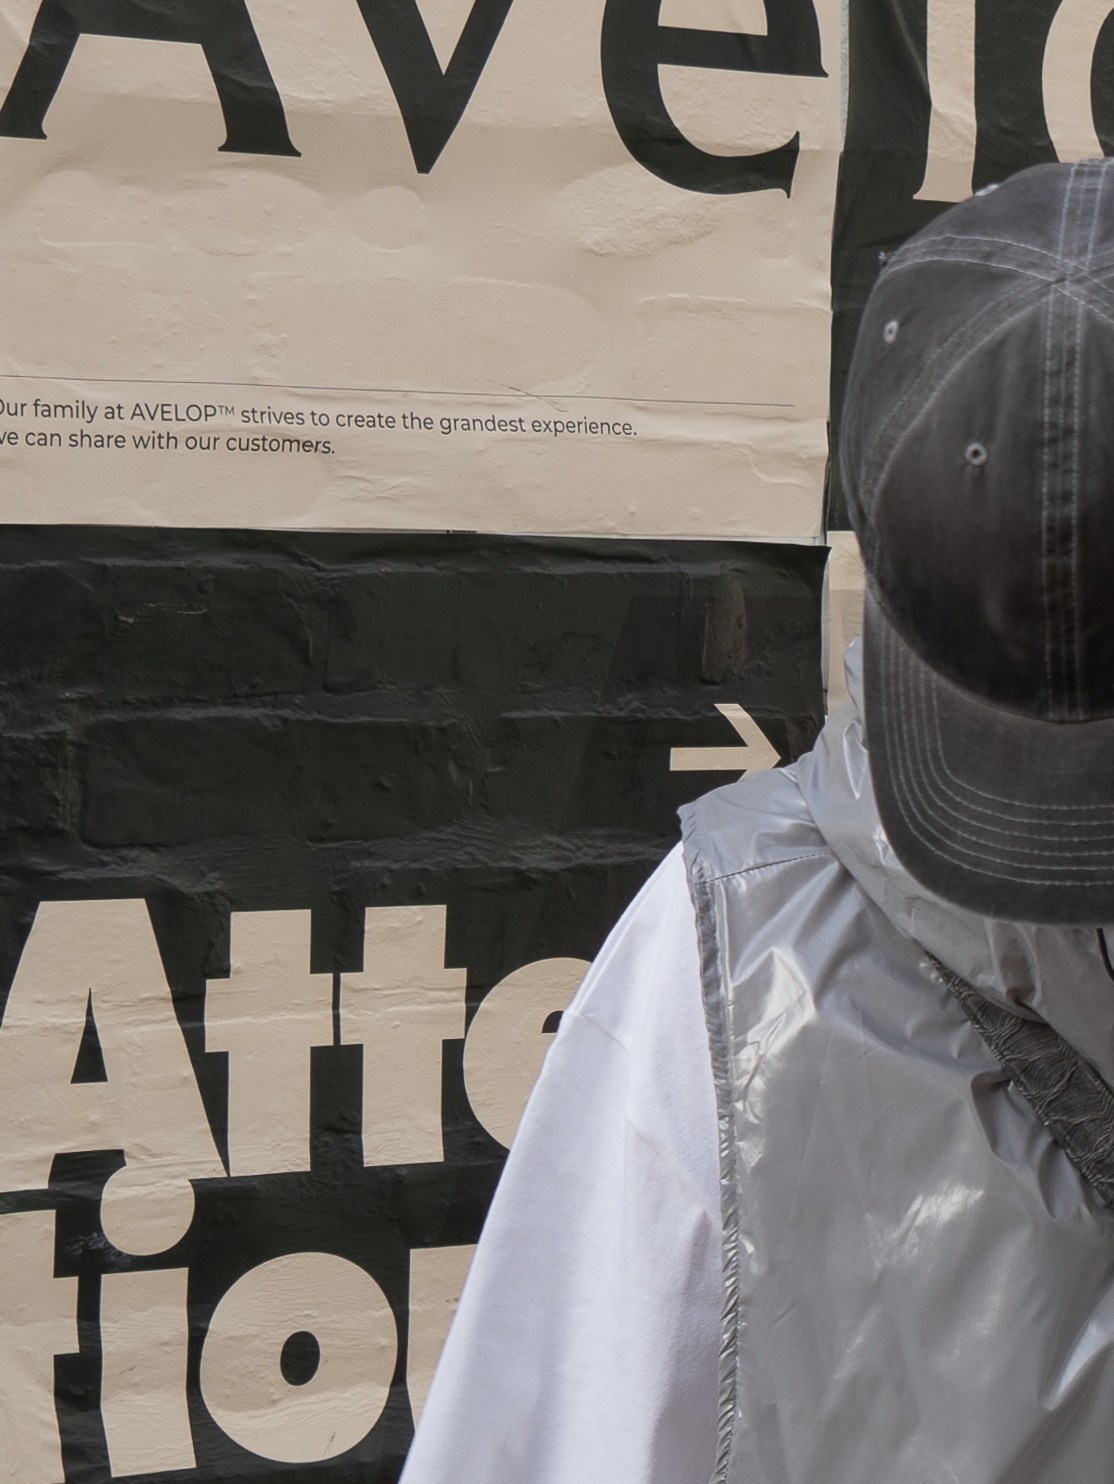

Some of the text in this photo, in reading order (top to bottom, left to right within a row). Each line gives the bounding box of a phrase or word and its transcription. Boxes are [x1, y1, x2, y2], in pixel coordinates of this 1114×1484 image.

[0, 399, 27, 416] ur
[33, 399, 98, 423] family
[105, 404, 124, 420] at
[241, 406, 305, 425] strives
[310, 411, 329, 426] to
[336, 413, 395, 428] create
[402, 412, 433, 430] the
[440, 415, 526, 435] grandest
[532, 417, 637, 437] experience.
[25, 432, 61, 446] can
[69, 429, 126, 448] share
[132, 431, 177, 449] with
[185, 436, 220, 450] our
[227, 436, 334, 454] customers.
